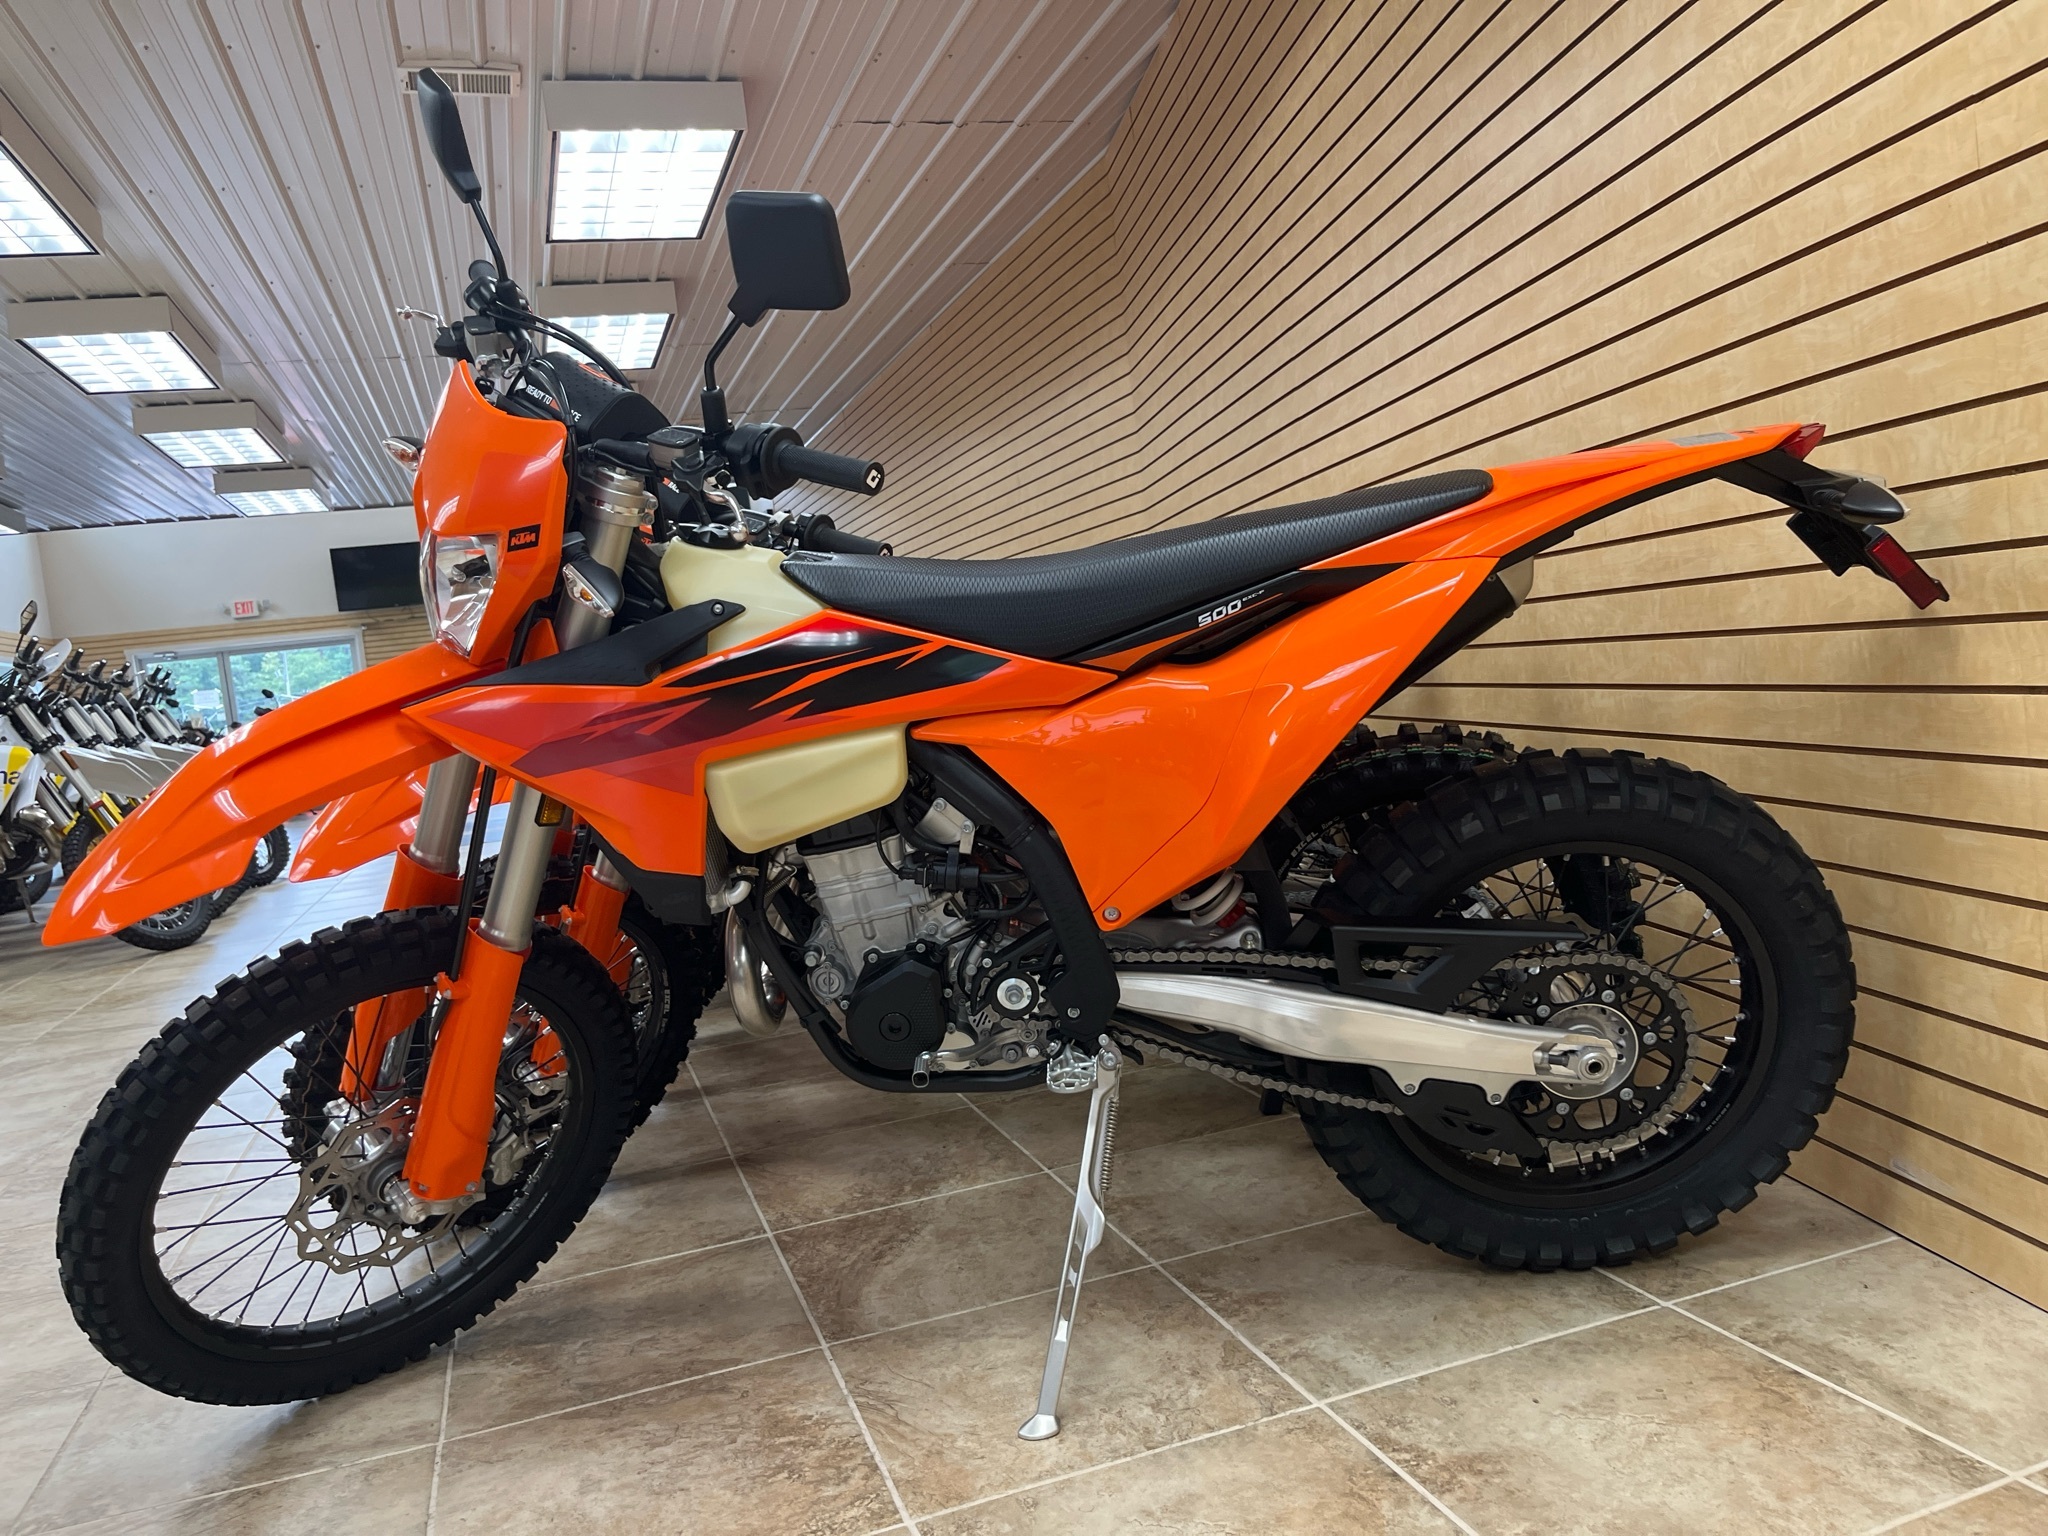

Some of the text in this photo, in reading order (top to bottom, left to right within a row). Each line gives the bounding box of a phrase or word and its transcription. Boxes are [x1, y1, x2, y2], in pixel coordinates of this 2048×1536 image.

[526, 384, 545, 400] READY
[543, 394, 553, 405] TO
[511, 531, 536, 546] KTM
[234, 600, 254, 615] EXIT
[1198, 599, 1242, 627] 500
[1291, 831, 1319, 858] EXCEL
